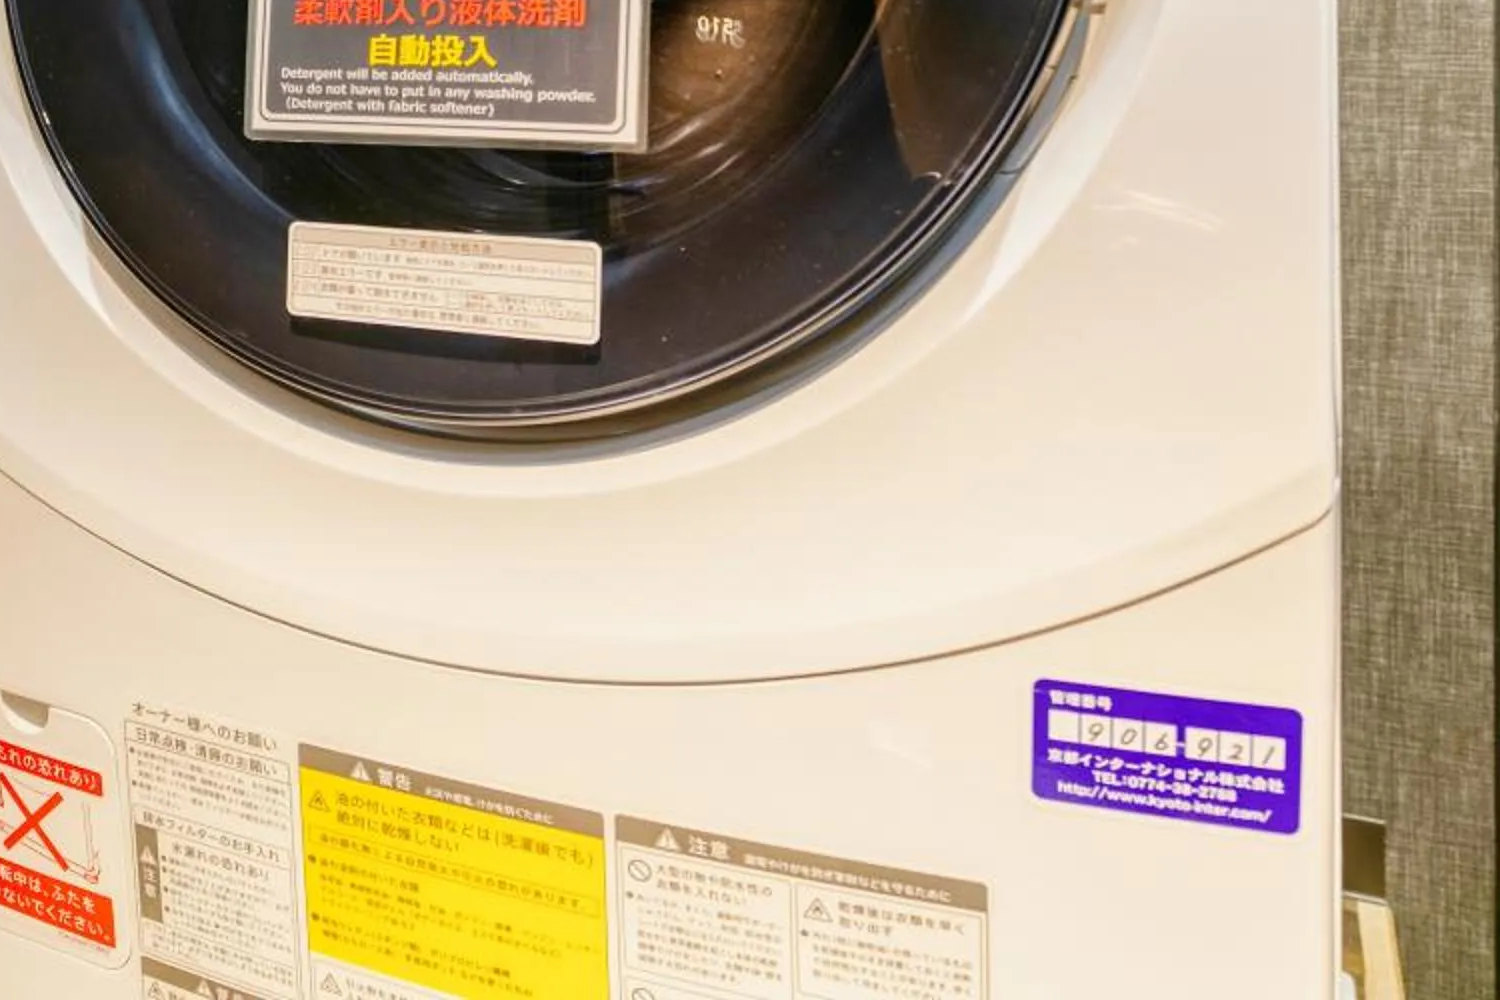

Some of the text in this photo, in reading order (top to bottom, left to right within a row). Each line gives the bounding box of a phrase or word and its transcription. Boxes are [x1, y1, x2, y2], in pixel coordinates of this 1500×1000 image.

[368, 33, 498, 68] 自動投入
[281, 66, 533, 86] Detergent will be added automatically.
[281, 81, 301, 93] You
[306, 82, 322, 94] do
[326, 83, 346, 95] not
[350, 83, 380, 96] have
[384, 85, 397, 96] to
[401, 86, 423, 99] put
[428, 85, 439, 97] in
[444, 88, 469, 101] any
[474, 86, 532, 103] washing
[357, 98, 383, 111] with
[388, 99, 425, 112] fabric
[430, 101, 495, 116] softener)
[688, 835, 730, 861] 注意
